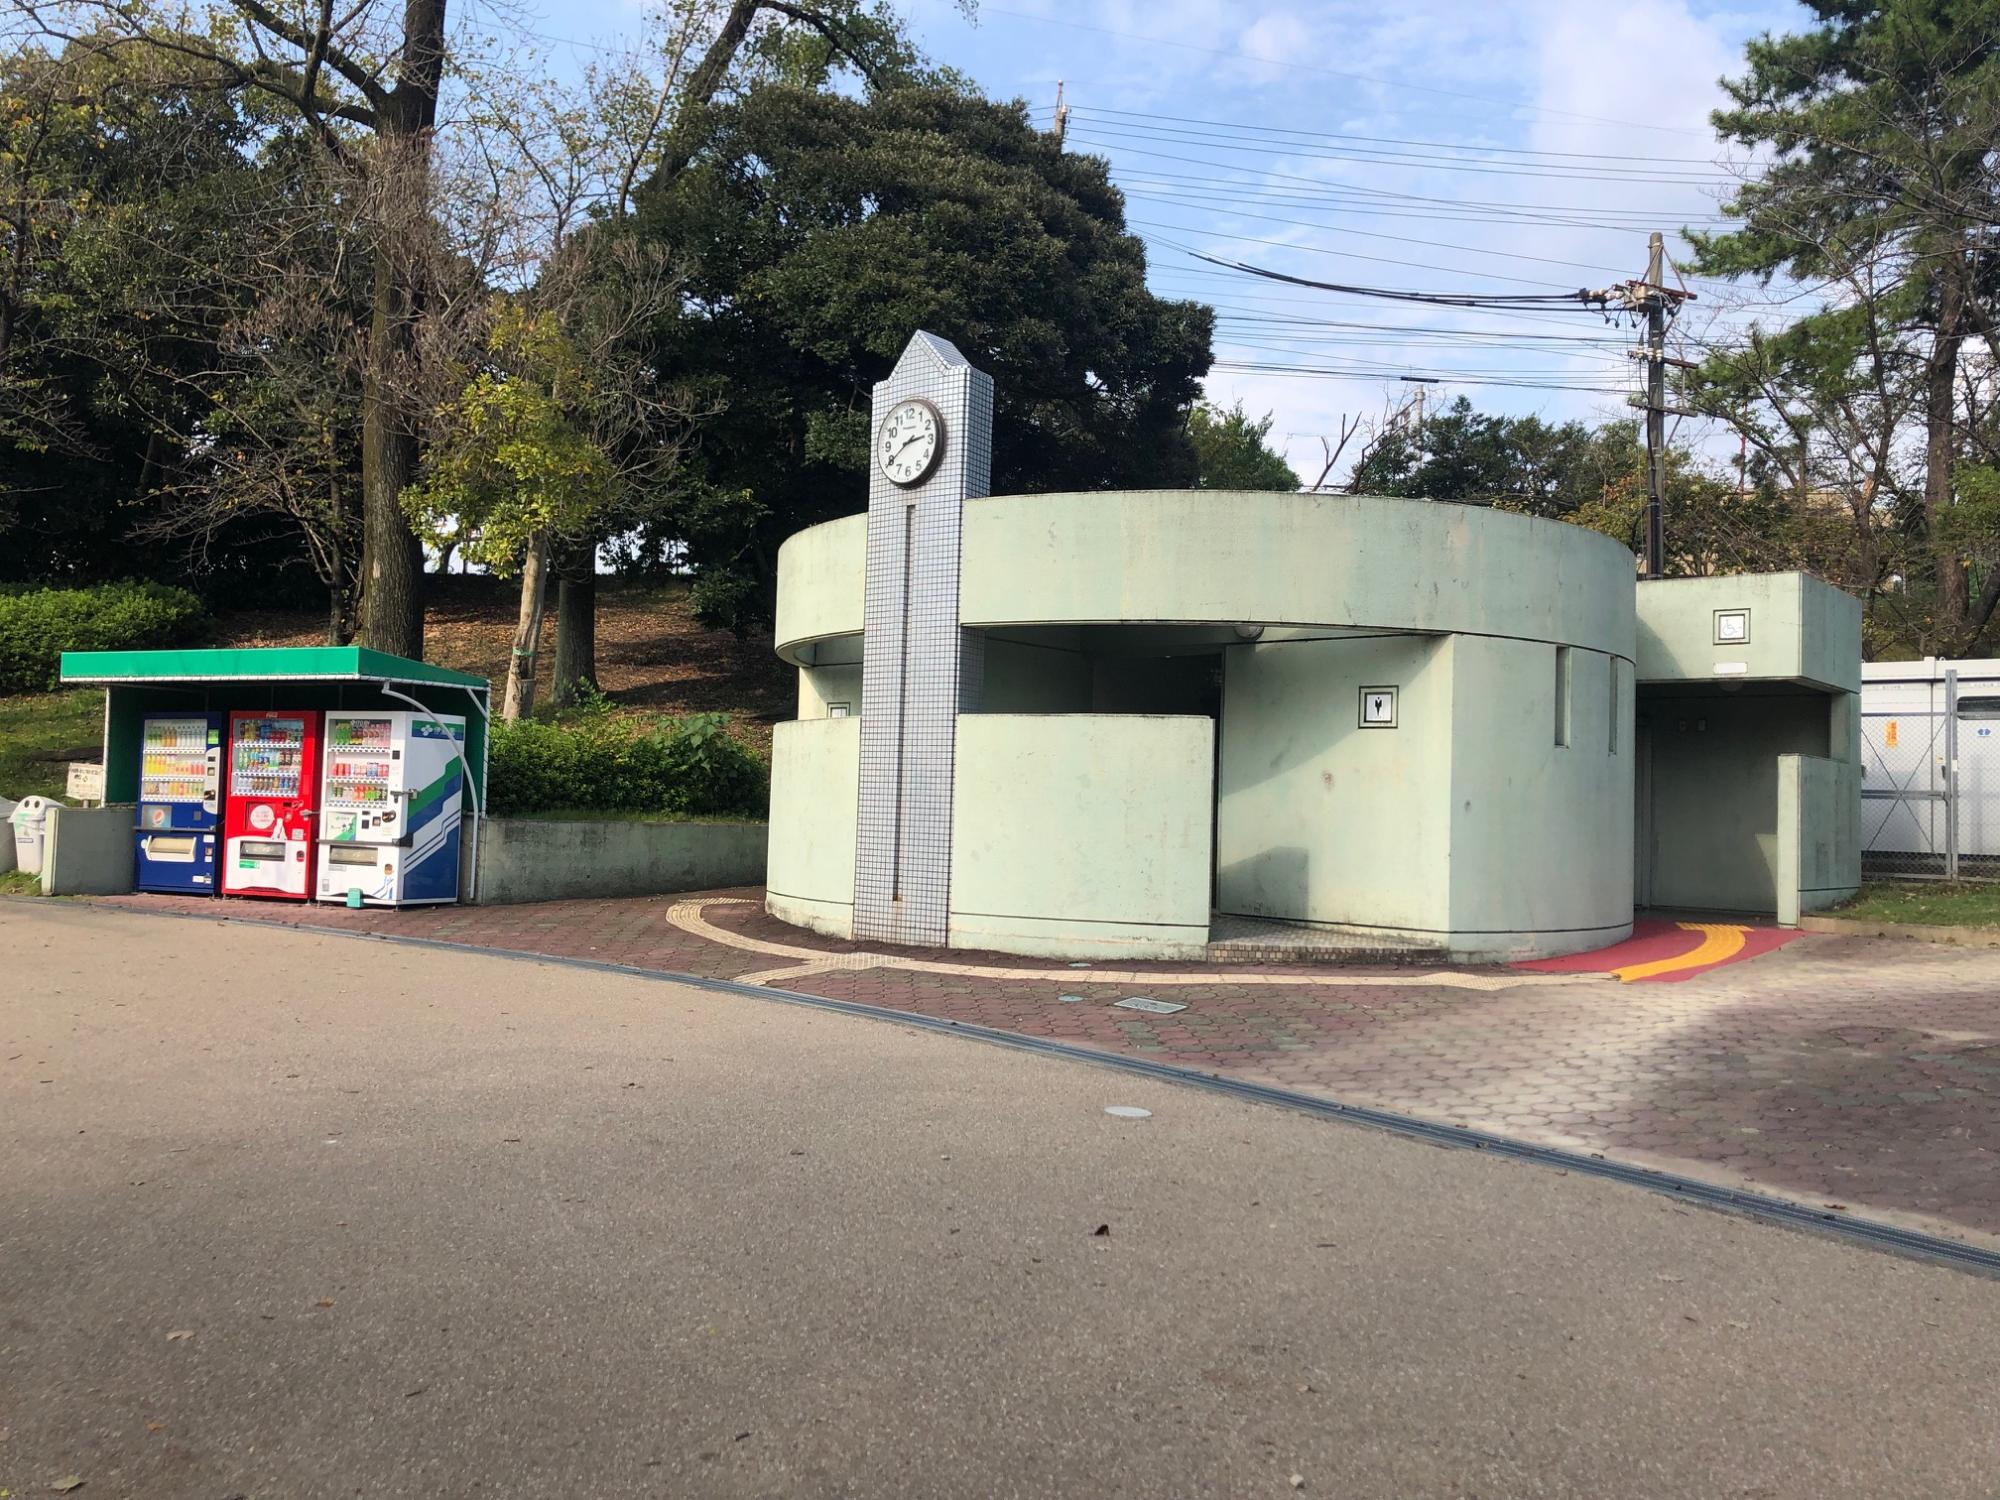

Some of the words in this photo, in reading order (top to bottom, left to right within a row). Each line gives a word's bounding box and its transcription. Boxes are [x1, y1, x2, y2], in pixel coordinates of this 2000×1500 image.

[904, 408, 915, 419] 12
[919, 411, 923, 421] 1
[925, 419, 931, 430] 2
[888, 427, 897, 438] 10
[928, 434, 934, 444] 3
[885, 441, 891, 452] 9
[923, 448, 929, 459] 4
[896, 463, 903, 474] 7
[915, 460, 922, 470] 5
[905, 466, 912, 477] 6
